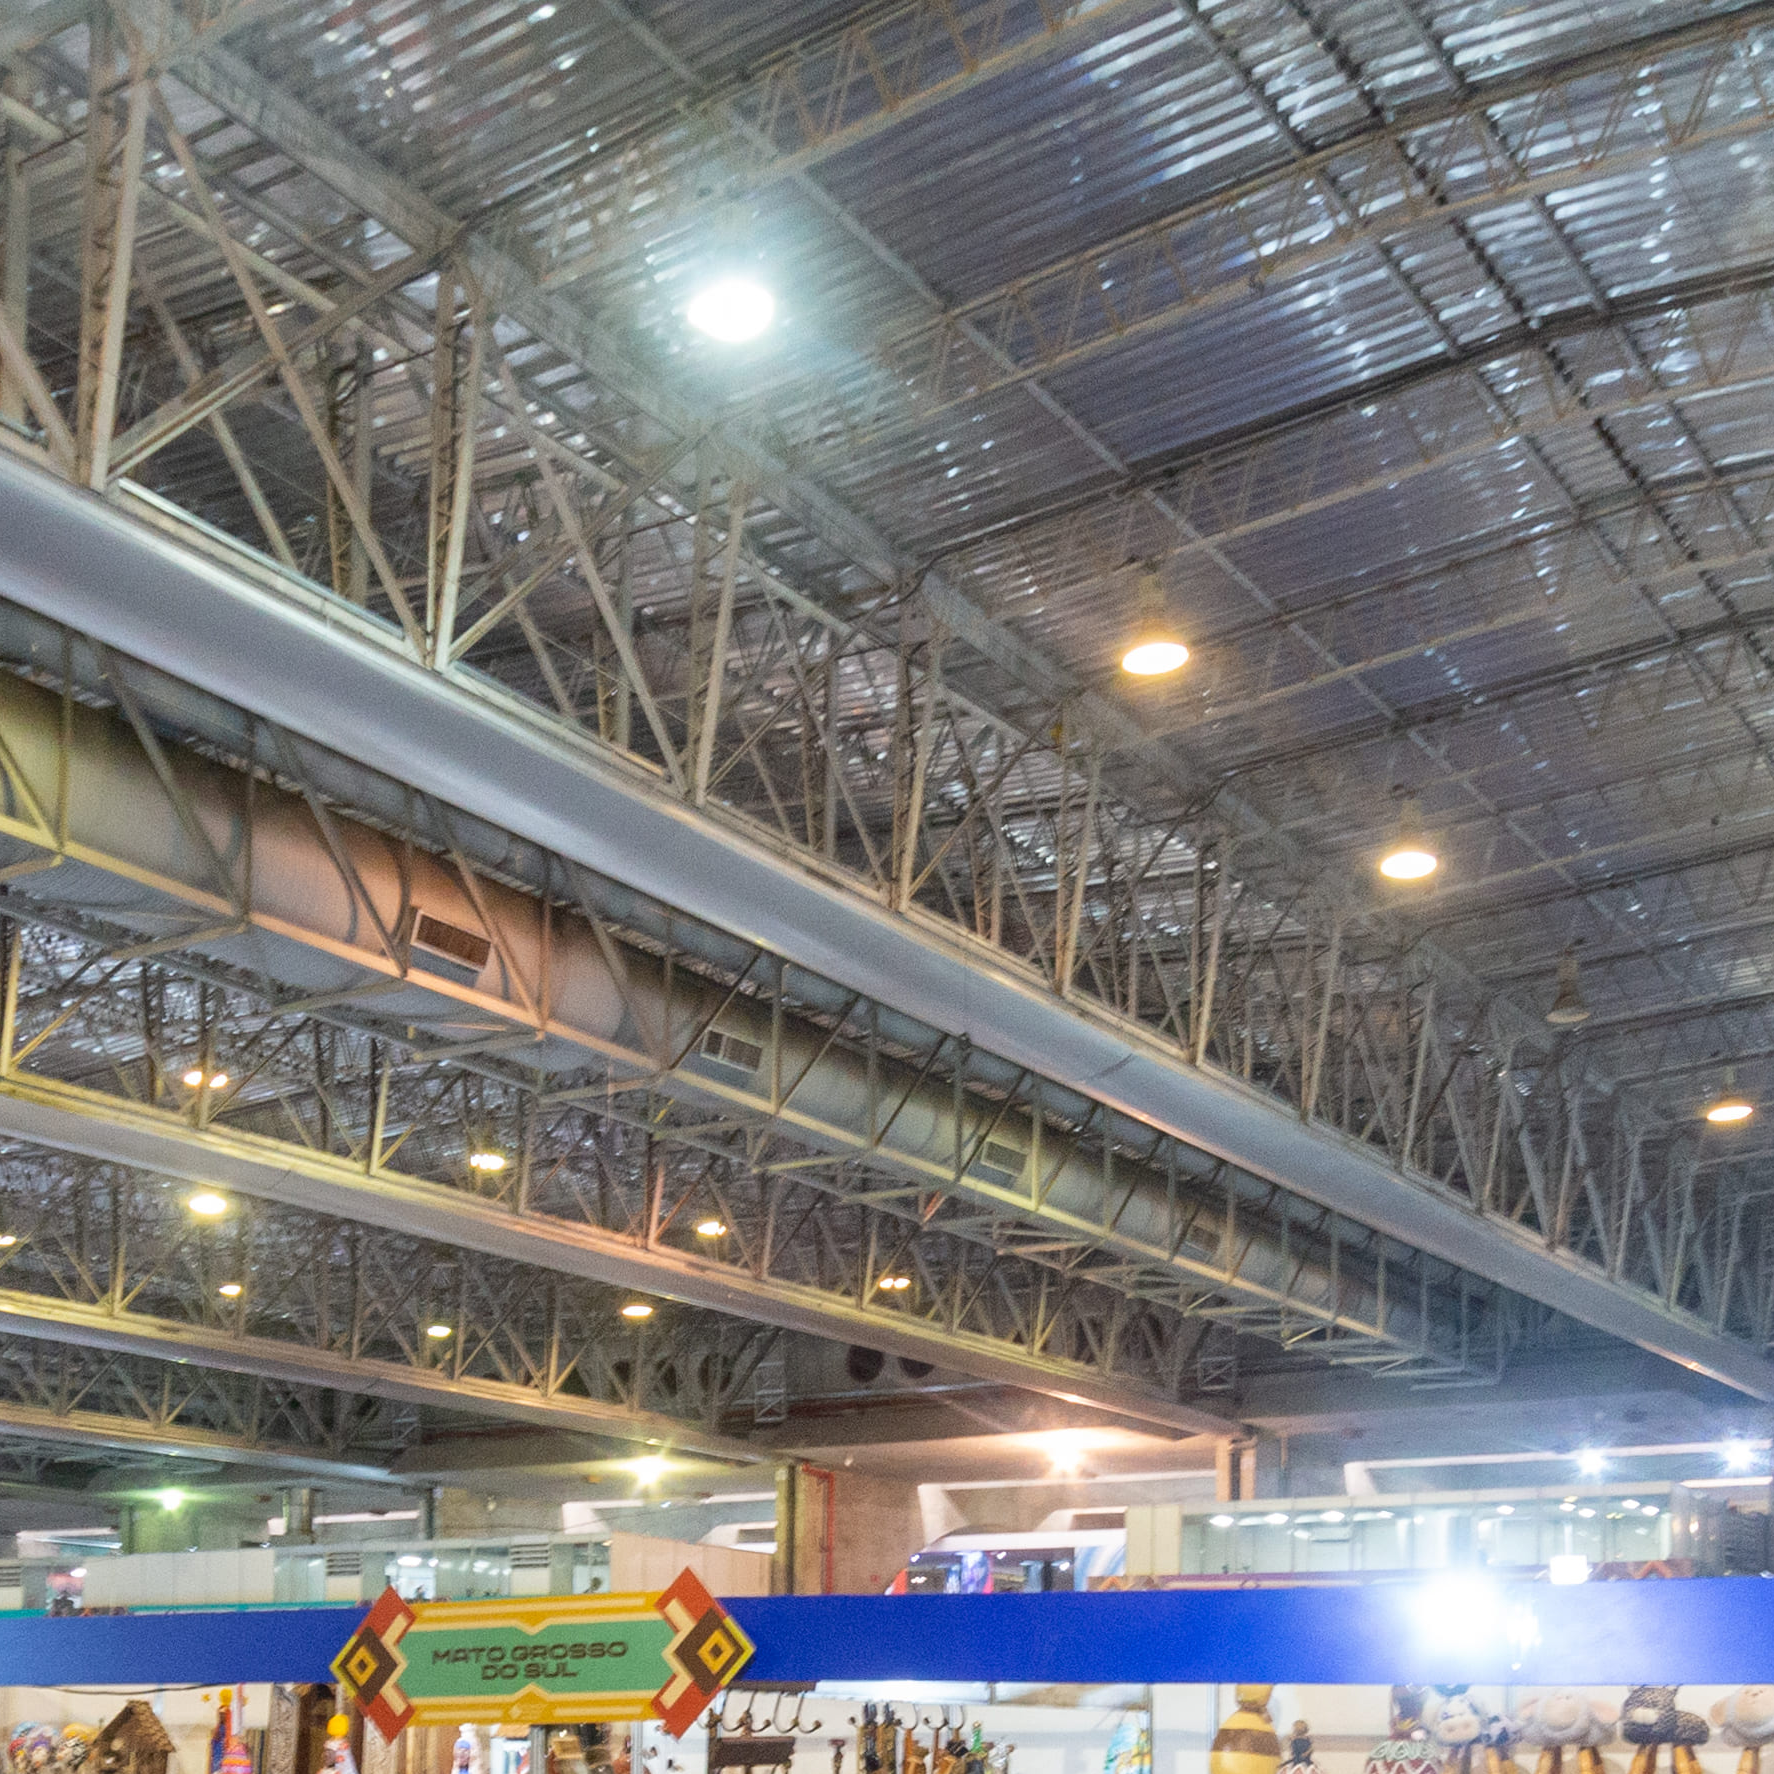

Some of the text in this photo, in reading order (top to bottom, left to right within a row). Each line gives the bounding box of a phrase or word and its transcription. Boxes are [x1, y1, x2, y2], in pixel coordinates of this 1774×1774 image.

[432, 1641, 629, 1665] MATO GROSSO
[481, 1661, 578, 1681] DO SUL
